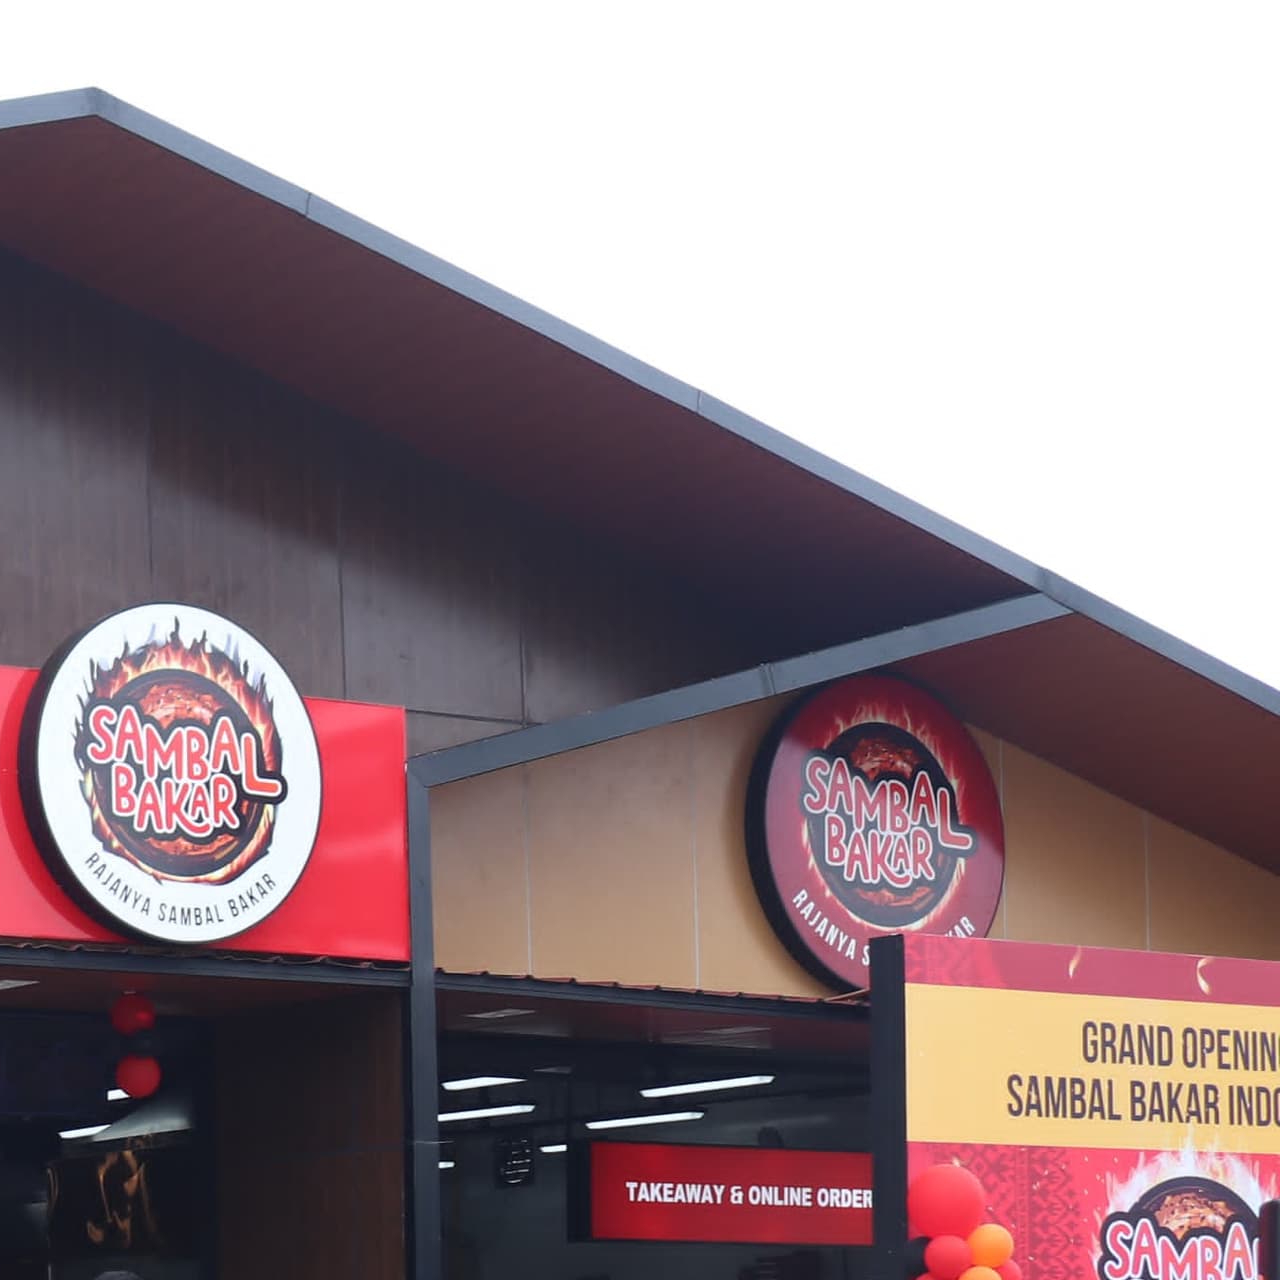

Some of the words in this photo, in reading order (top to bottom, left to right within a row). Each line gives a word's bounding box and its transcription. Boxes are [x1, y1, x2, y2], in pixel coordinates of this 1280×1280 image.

[88, 704, 282, 796] SAMBAL
[113, 763, 238, 836] BAKAR
[802, 756, 973, 850] SAMBAL
[824, 813, 936, 889] BAKAR
[84, 851, 151, 917] RAJANYA
[157, 902, 225, 927] SAMBAL
[227, 872, 277, 918] BAKAR
[791, 888, 857, 961] RAJANYA
[1081, 1020, 1174, 1068] GRAND
[1182, 1027, 1280, 1072] OPENIN
[1006, 1073, 1122, 1122] SAMBAL
[1131, 1080, 1220, 1126] BAKAR
[625, 1181, 726, 1205] TAKEAWAY
[730, 1186, 744, 1205] &
[748, 1186, 813, 1207] ONLINE
